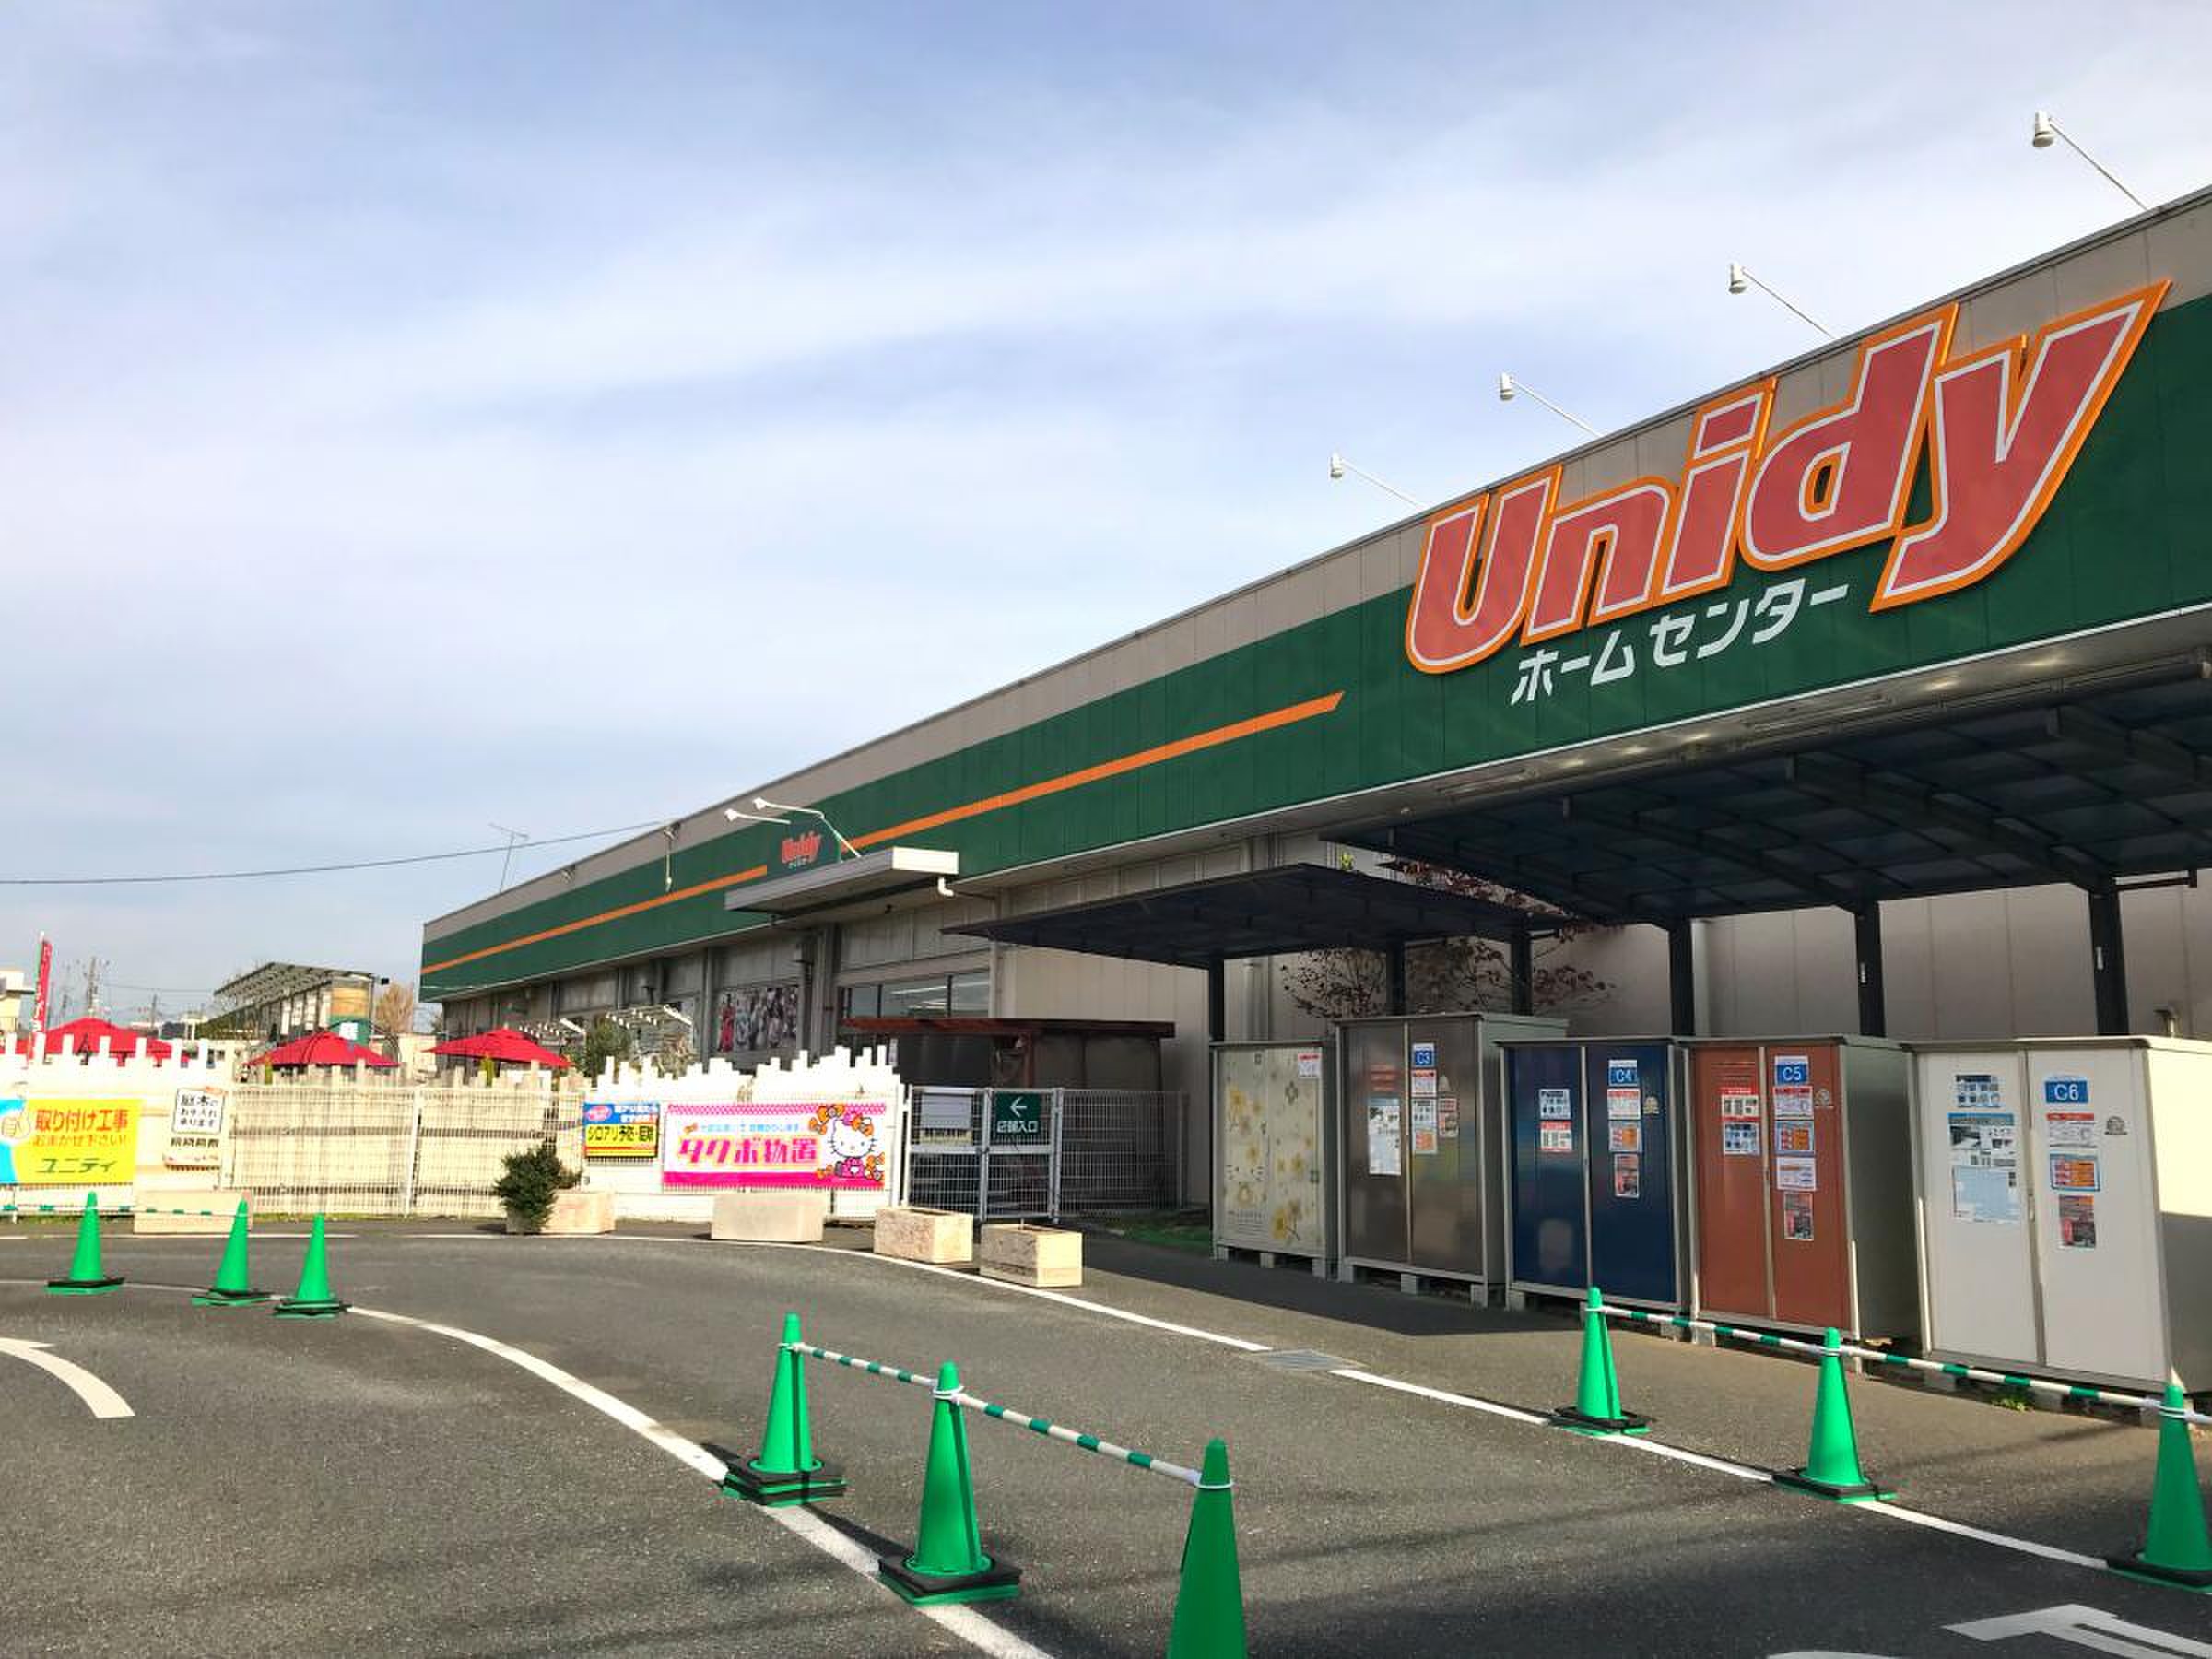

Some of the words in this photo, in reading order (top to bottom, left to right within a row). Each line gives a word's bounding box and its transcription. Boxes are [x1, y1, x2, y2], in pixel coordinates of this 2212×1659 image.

[1406, 280, 2171, 674] Unidy
[1511, 578, 1849, 705] ホームセンター
[1616, 1069, 1632, 1082] C4
[1783, 1066, 1802, 1081] C5
[2053, 1083, 2080, 1100] C6
[35, 1109, 128, 1132] 取り付け工事
[996, 1121, 1039, 1134] 店舗入口
[678, 1136, 818, 1164] タクボ物置
